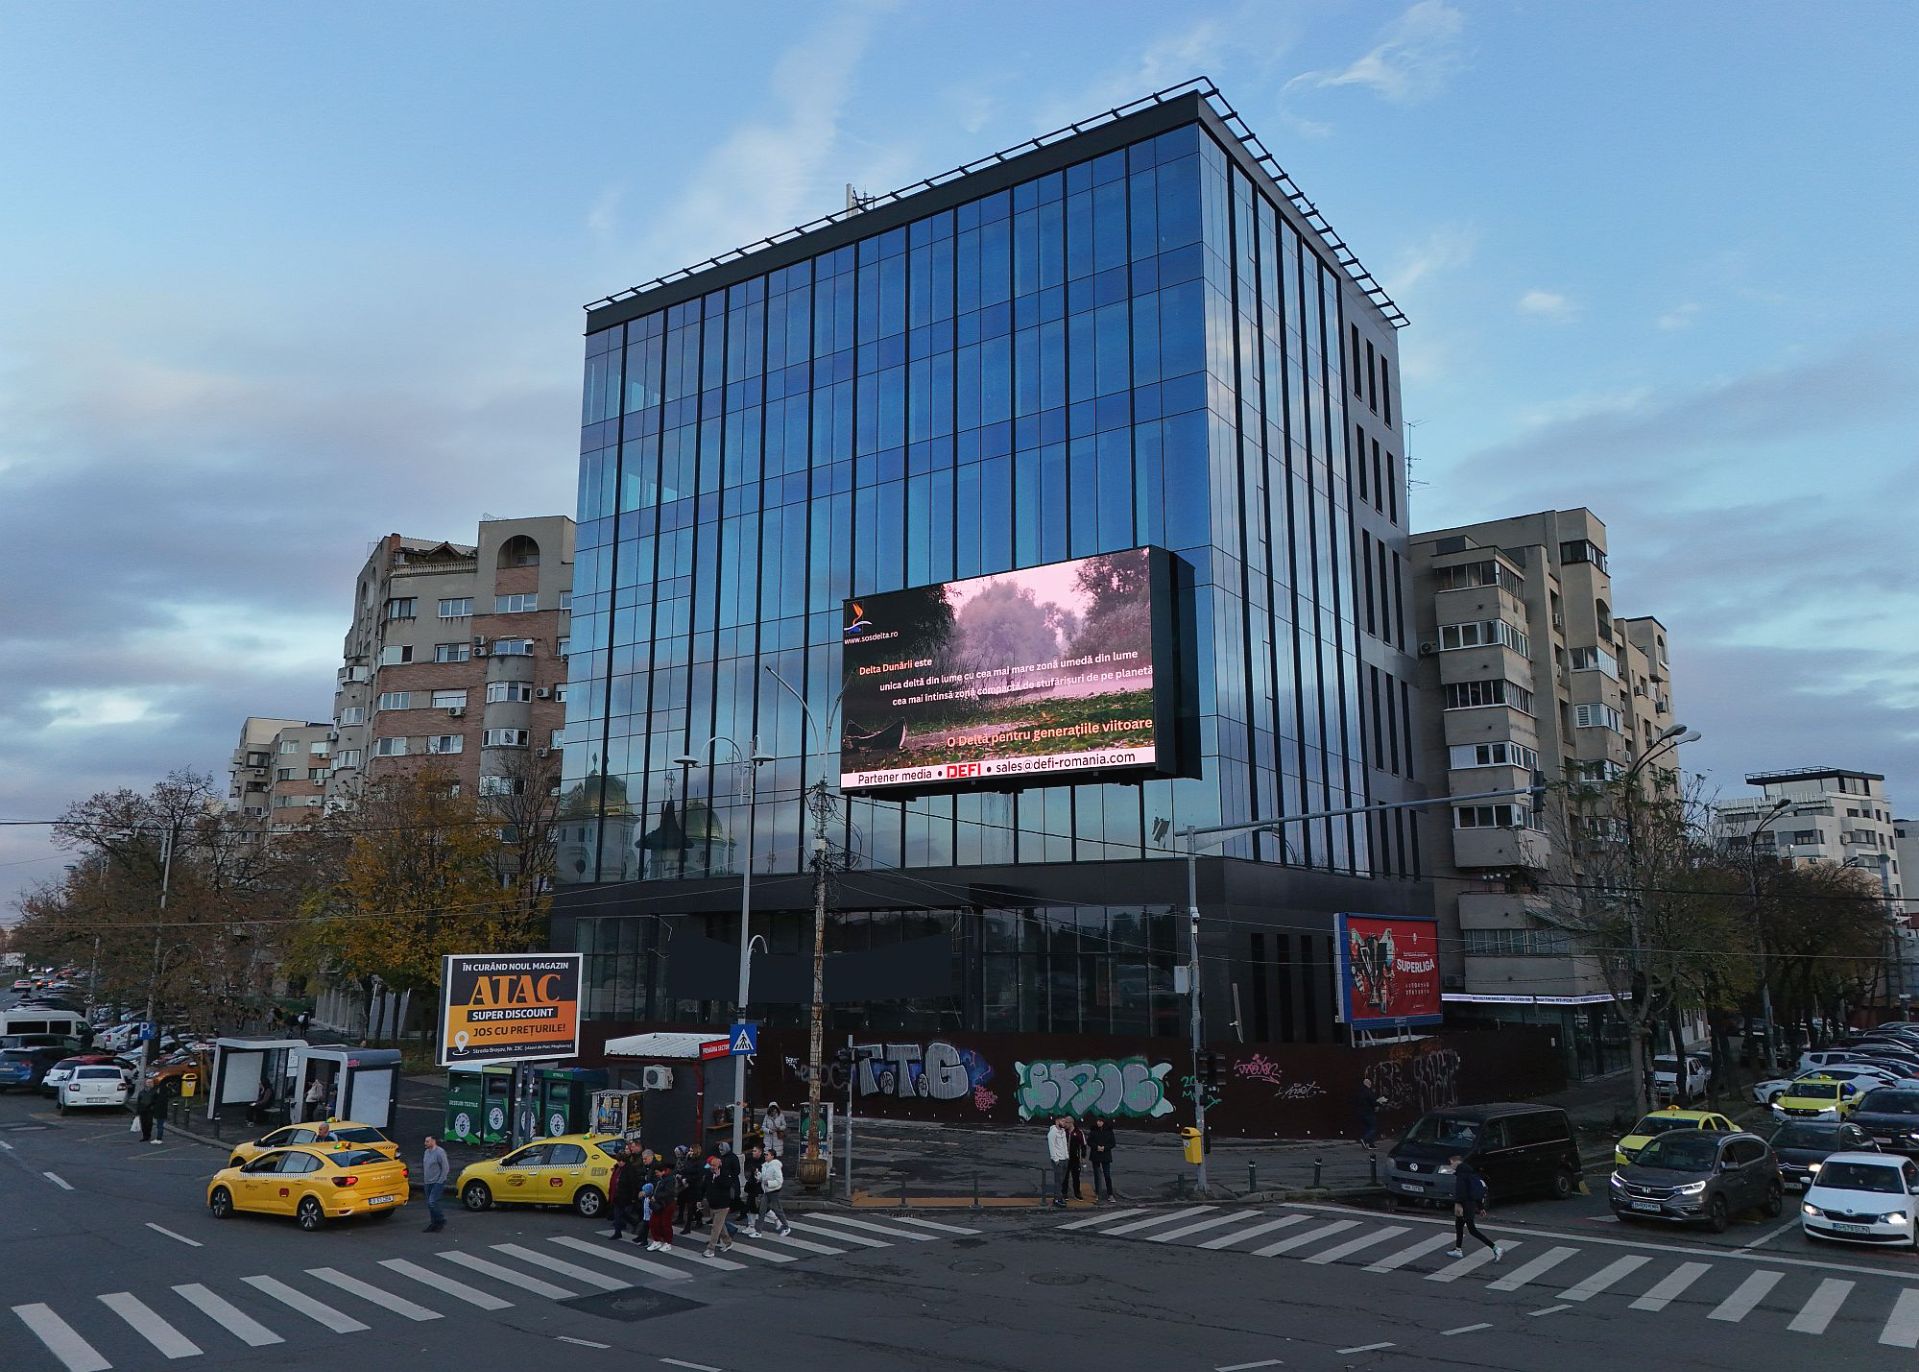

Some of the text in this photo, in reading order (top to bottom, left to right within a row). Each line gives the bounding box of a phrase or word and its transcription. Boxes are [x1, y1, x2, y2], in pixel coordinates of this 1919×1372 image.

[844, 631, 899, 645] www.sosdelta.ro
[859, 664, 881, 676] Delta
[914, 658, 933, 668] este
[880, 680, 902, 691] unica
[926, 674, 940, 686] din
[941, 672, 963, 683] lume
[964, 671, 975, 681] cu
[976, 669, 992, 679] cea
[993, 666, 1010, 677] mai
[1011, 664, 1035, 674] mare
[1060, 655, 1093, 668] umedă
[1095, 652, 1111, 664] din
[1113, 651, 1138, 662] lume
[892, 696, 907, 706] cea
[908, 693, 924, 705] mai
[1086, 671, 1099, 682] de
[1101, 671, 1114, 682] pe
[1115, 665, 1153, 680] planetă
[947, 737, 956, 748] O
[991, 730, 1031, 745] pentru
[1102, 718, 1153, 733] viitoare
[858, 752, 1136, 785] Partener media DEFI sales@defi-romania.com
[509, 962, 531, 971] NOUL
[532, 962, 569, 970] MAGAZIN
[1396, 958, 1435, 974] SUPERLIGA
[468, 973, 561, 1006] ATAC
[472, 1008, 554, 1021] SUPER DISCOUNT
[473, 1027, 492, 1037] JOS
[494, 1026, 508, 1036] CU
